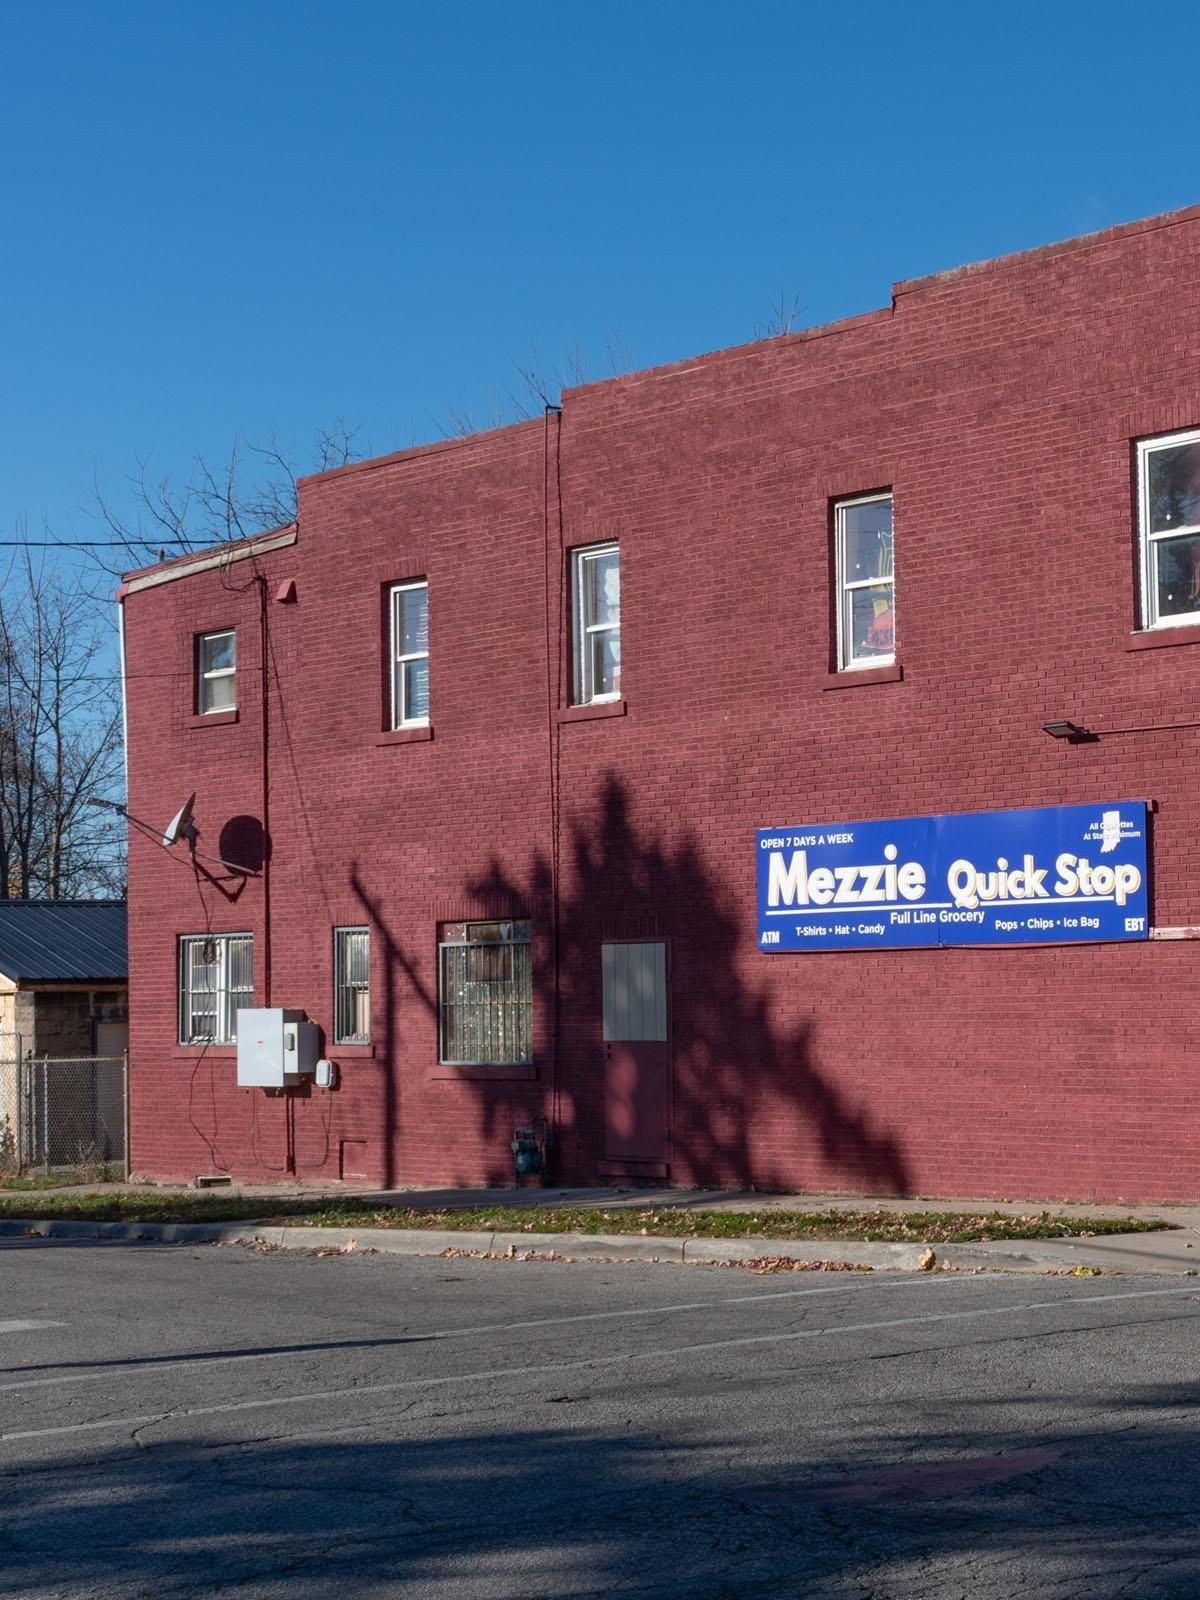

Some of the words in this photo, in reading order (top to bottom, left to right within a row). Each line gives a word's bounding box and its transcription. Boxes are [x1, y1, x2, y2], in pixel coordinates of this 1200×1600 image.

[1089, 822, 1099, 830] All
[760, 838, 784, 849] OPEN
[786, 837, 792, 848] 7
[793, 836, 816, 848] DAYS
[818, 835, 825, 845] A
[827, 833, 854, 844] WEEK
[1083, 832, 1090, 840] At
[1092, 832, 1105, 840] Sta
[768, 843, 926, 906] Mezzie
[947, 854, 1050, 909] Quick
[1054, 852, 1141, 906] Stop
[890, 911, 911, 924] Full
[914, 910, 936, 924] Line
[940, 910, 985, 923] Grocery
[995, 919, 1018, 932] Pops
[1027, 918, 1054, 930] Chips
[1063, 917, 1078, 928] Ice
[1080, 916, 1100, 928] Bag
[796, 926, 827, 936] T-Shirts
[834, 924, 850, 935] Hat
[858, 923, 886, 936] Candy
[1124, 917, 1145, 932] EBT
[761, 930, 780, 944] ATM
